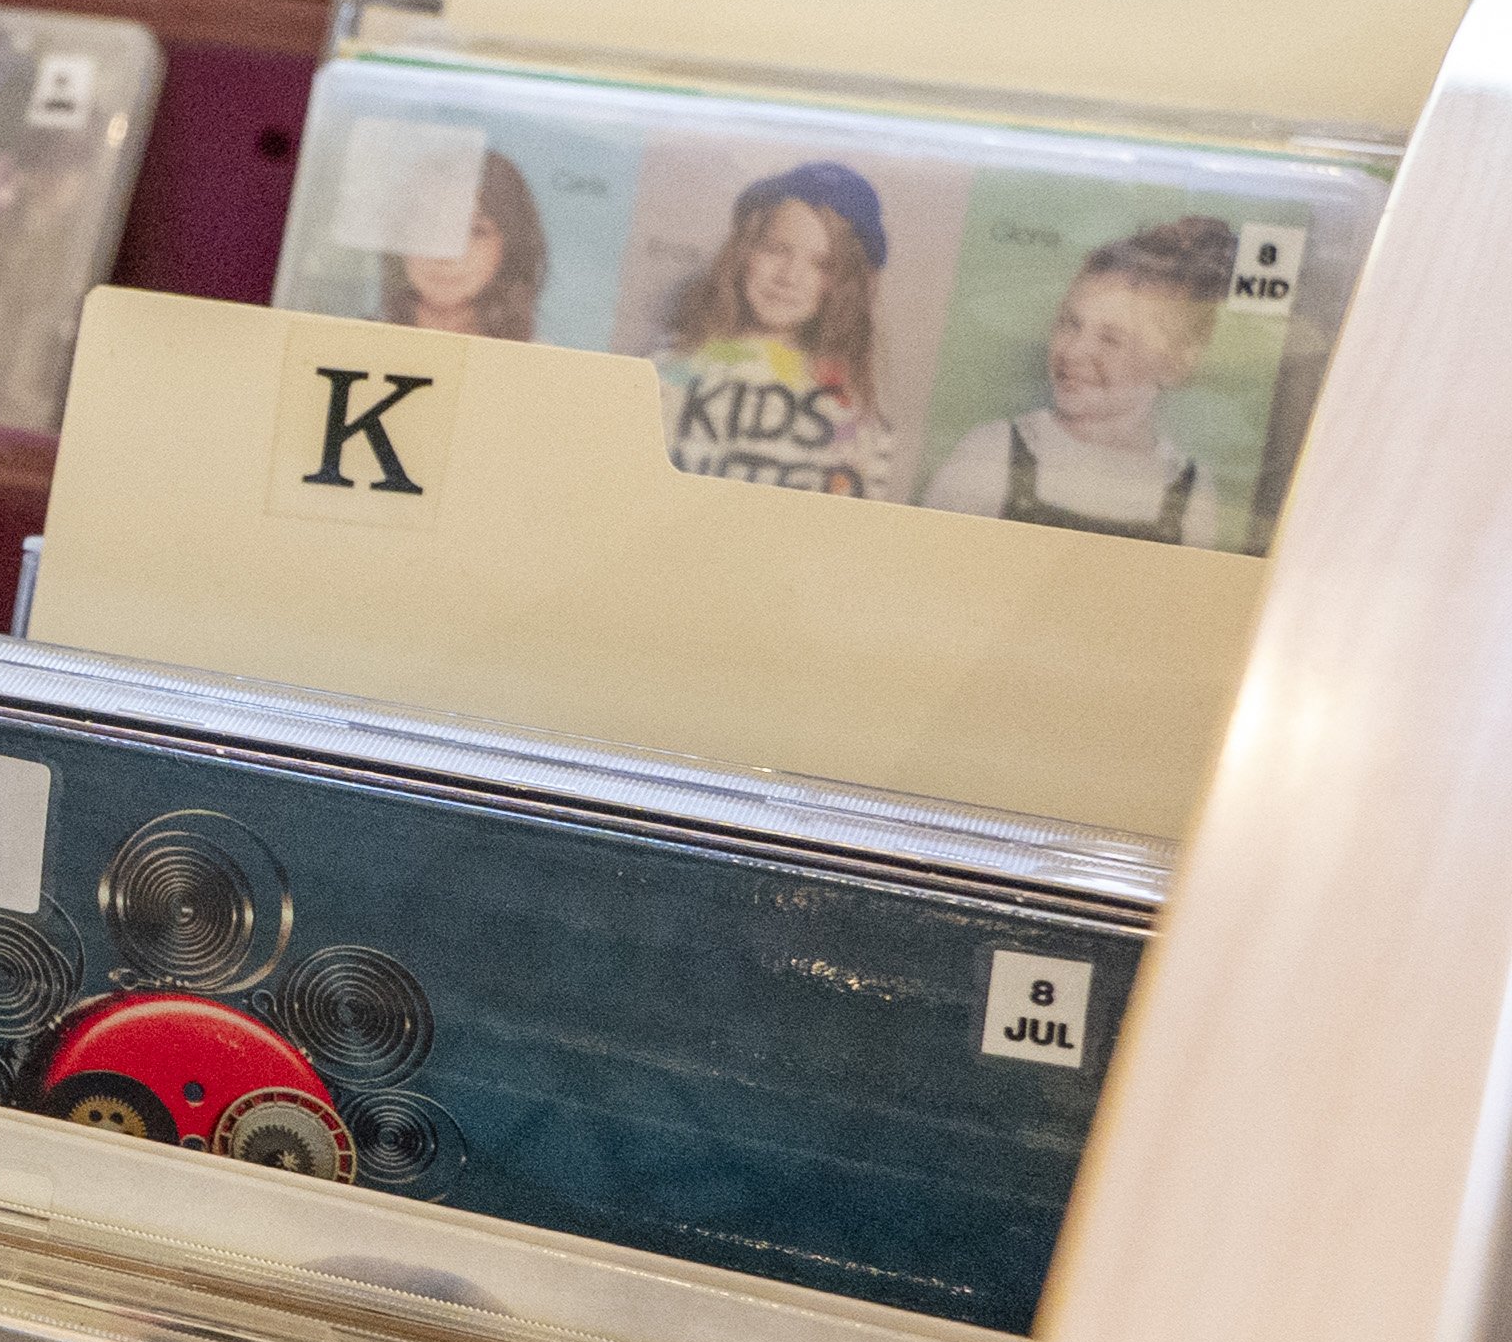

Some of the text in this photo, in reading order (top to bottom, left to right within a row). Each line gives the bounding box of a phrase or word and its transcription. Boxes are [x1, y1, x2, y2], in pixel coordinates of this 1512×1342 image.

[1258, 243, 1277, 267] 8
[1235, 274, 1291, 302] KID
[677, 376, 848, 449] KIDS
[301, 366, 434, 496] K
[1030, 979, 1055, 1008] 8
[1003, 1015, 1075, 1050] JUL
